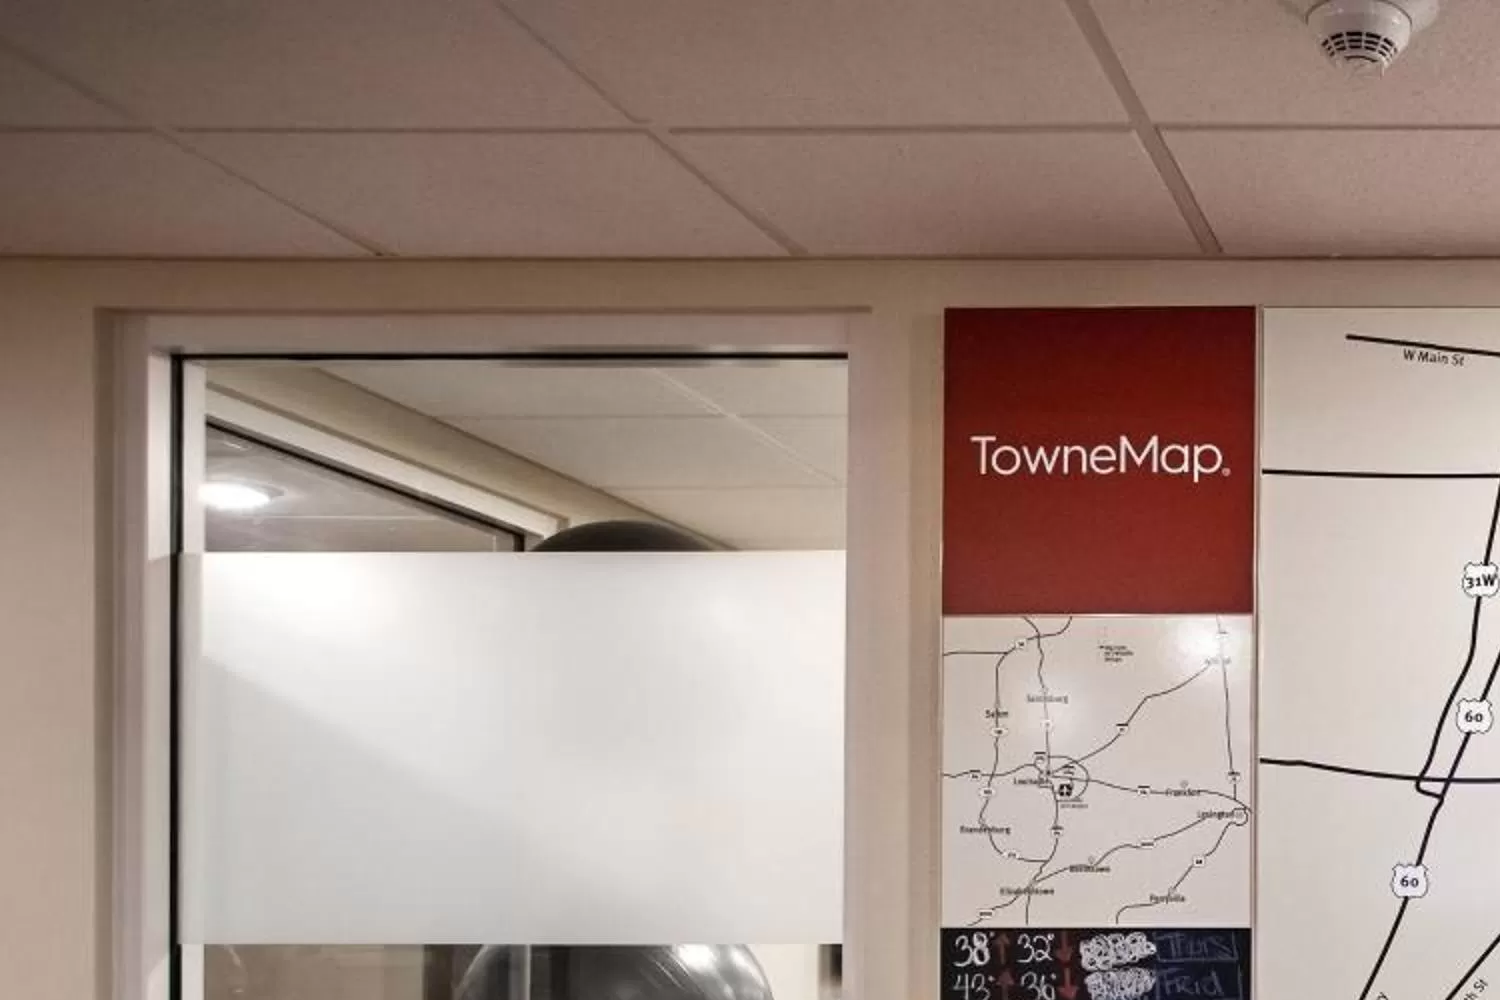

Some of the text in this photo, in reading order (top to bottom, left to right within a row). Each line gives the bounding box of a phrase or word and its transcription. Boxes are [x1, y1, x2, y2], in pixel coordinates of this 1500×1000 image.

[1403, 349, 1465, 367] W Main St
[1465, 573, 1496, 588] 31W
[1464, 710, 1484, 724] 60
[1400, 875, 1420, 888] 60
[1472, 978, 1489, 995] St
